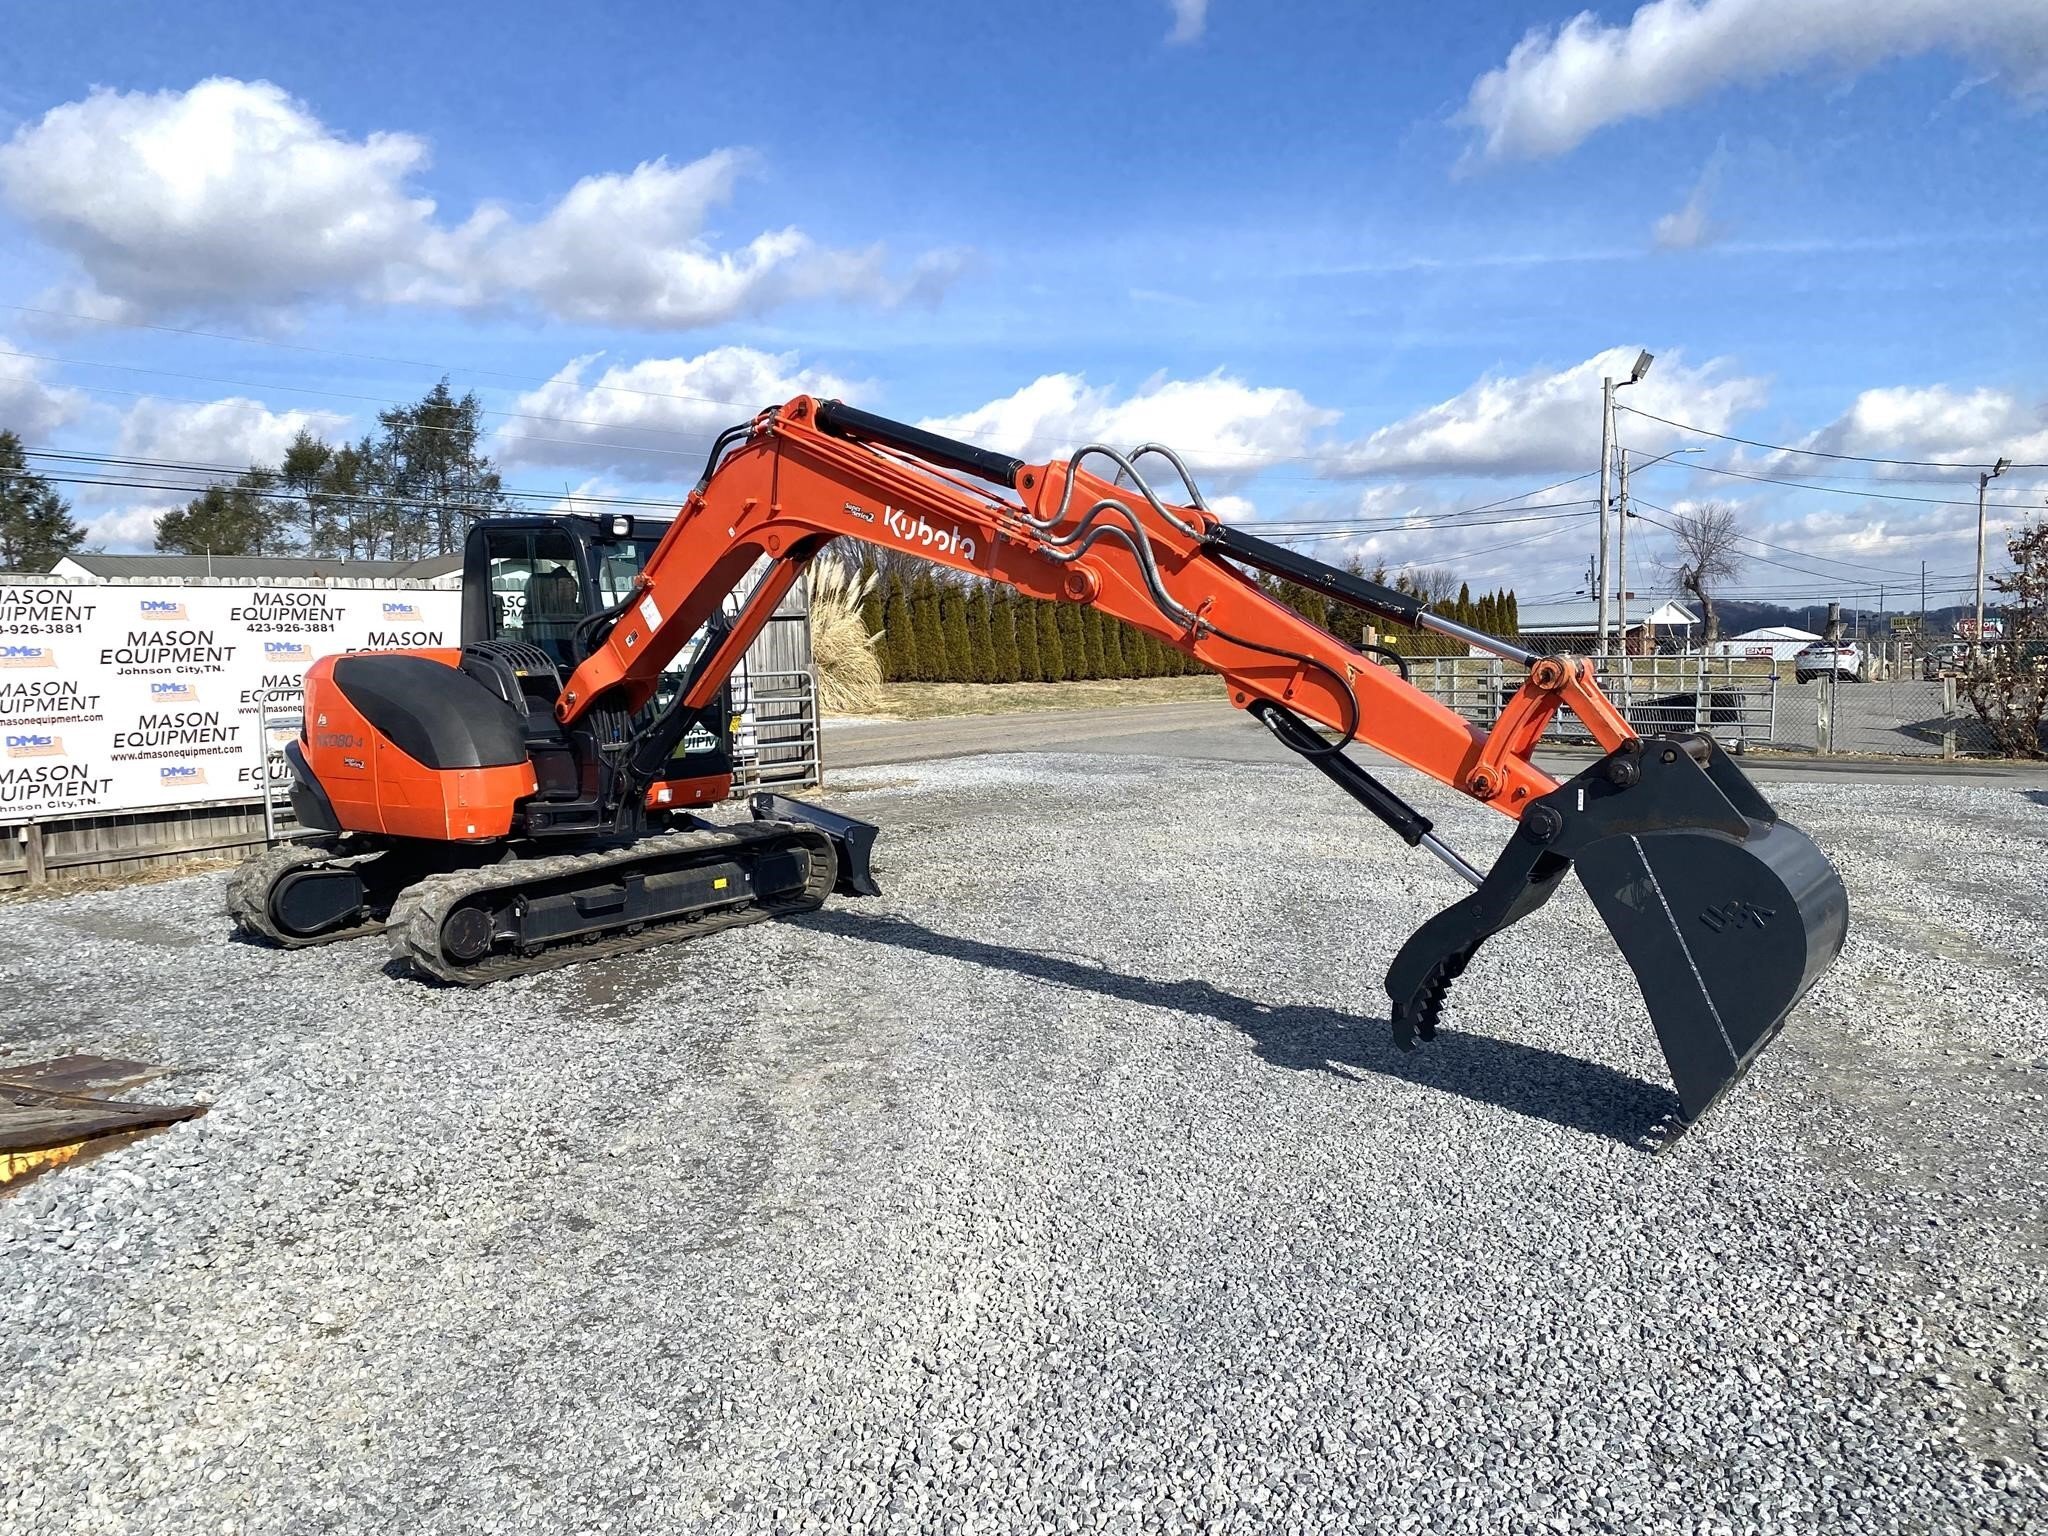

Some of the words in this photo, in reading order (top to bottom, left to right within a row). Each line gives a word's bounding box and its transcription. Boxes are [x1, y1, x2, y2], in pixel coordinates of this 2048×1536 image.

[883, 505, 975, 560] Kubota
[0, 590, 72, 604] ASON
[253, 593, 326, 606] MASON
[230, 607, 346, 621] EQUIPMENT
[246, 623, 335, 632] 423-926-3881
[127, 630, 213, 646] MASON
[367, 632, 443, 646] MASON
[100, 647, 236, 664] EQUIPMENT
[116, 667, 172, 675] Johnson
[139, 712, 219, 730] MASON
[113, 726, 240, 748] EQUIPMENT
[110, 745, 243, 761] www.dmasonequipment.com
